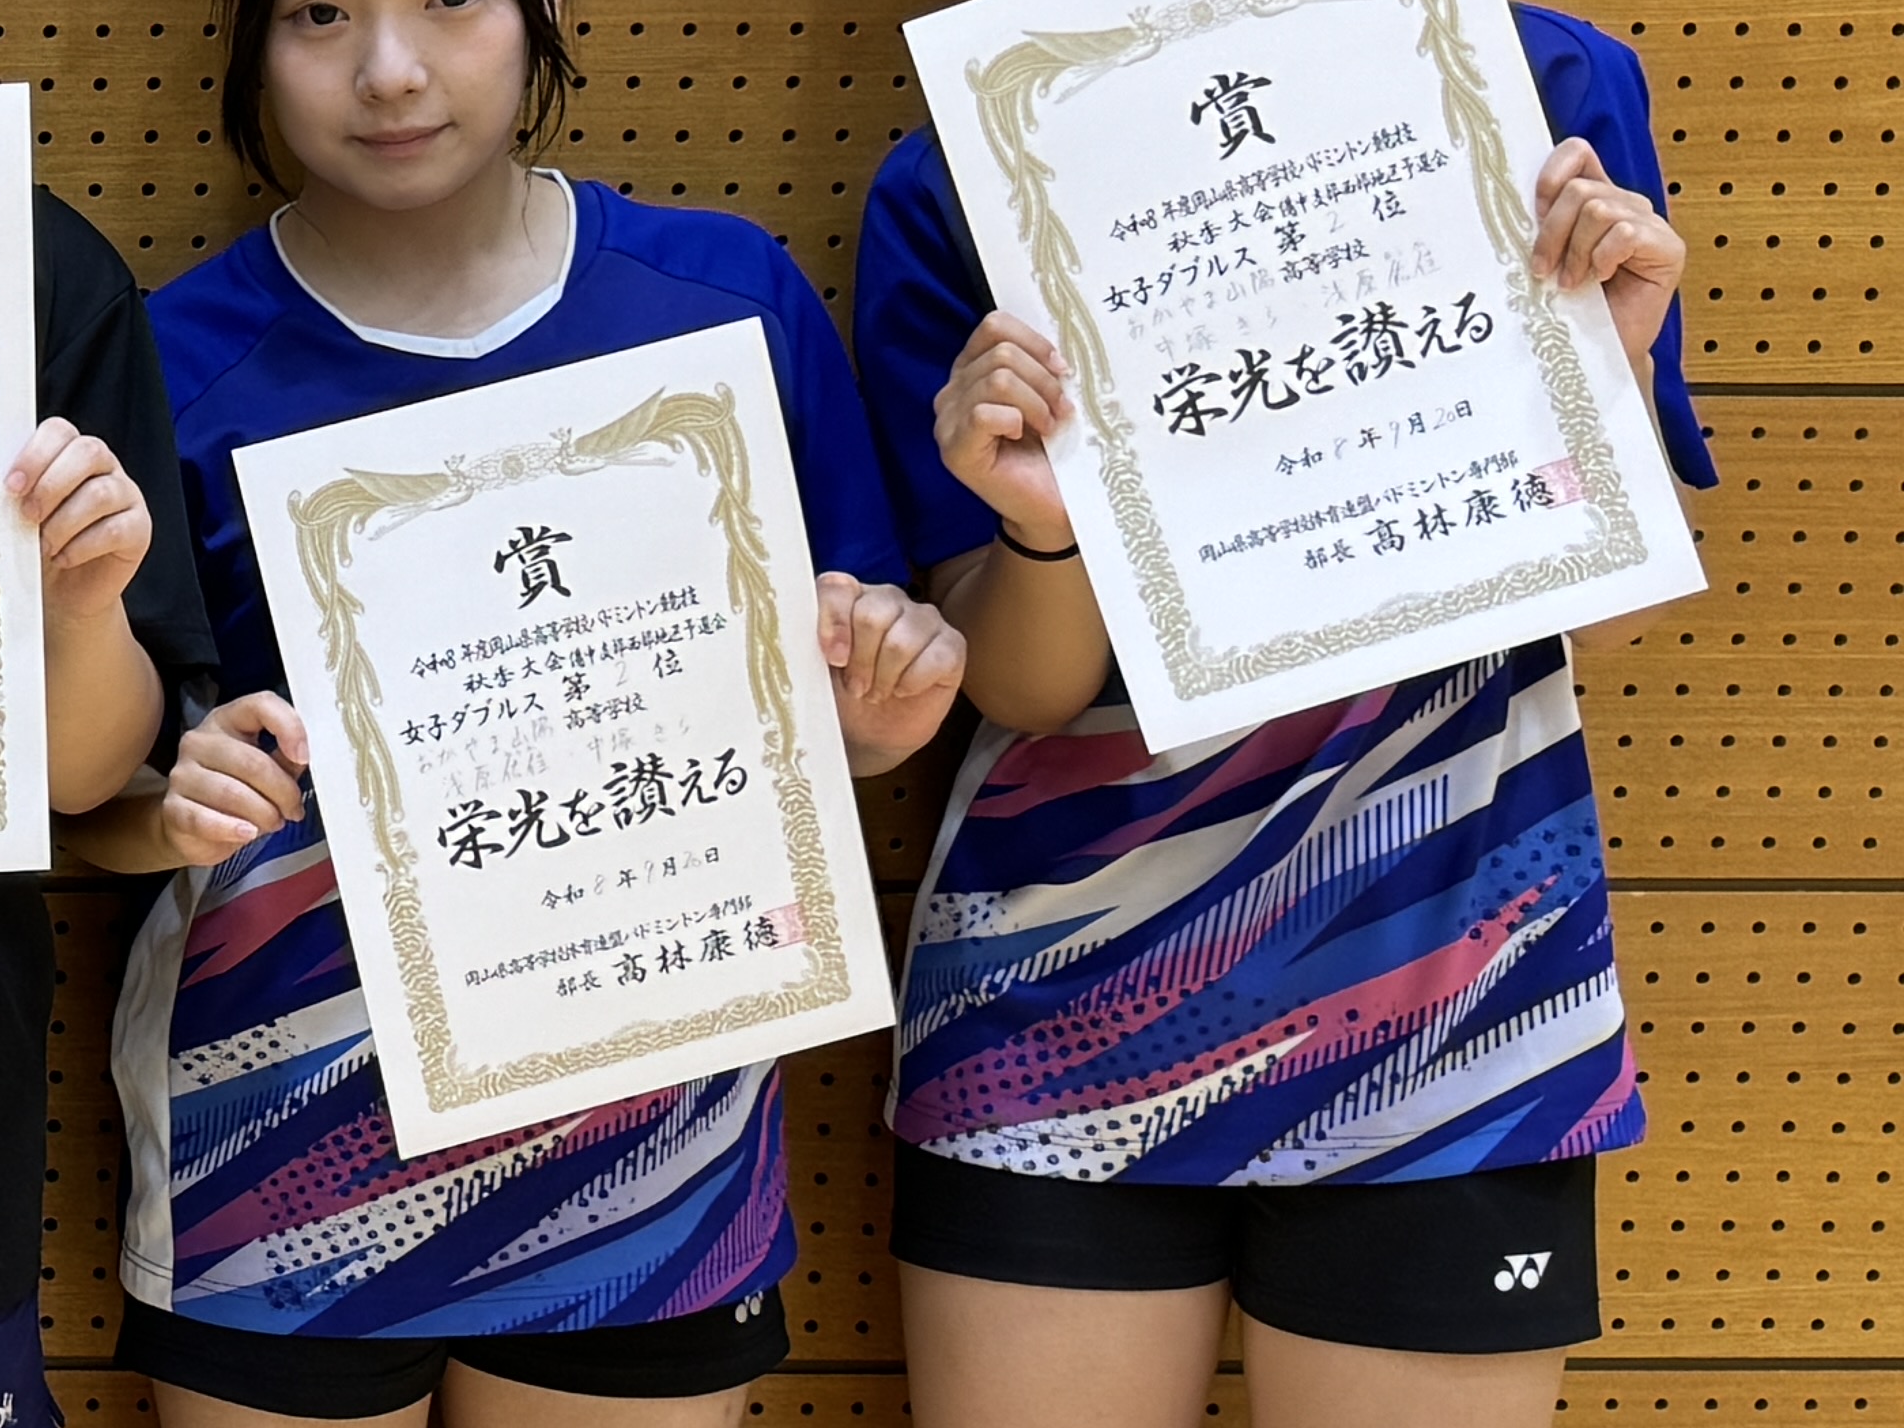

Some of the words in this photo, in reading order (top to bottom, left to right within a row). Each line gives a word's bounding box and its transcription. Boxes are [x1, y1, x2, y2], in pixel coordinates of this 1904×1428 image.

[1189, 72, 1275, 160] 賞
[1102, 247, 1258, 312] 女子ダブルス
[1153, 291, 1493, 436] 栄光を讃える
[493, 525, 573, 609] 賞
[1303, 541, 1355, 571] 部長
[399, 692, 545, 746] 女子ダブルス
[437, 748, 748, 869] 栄光を讃える
[556, 972, 602, 997] 部長
